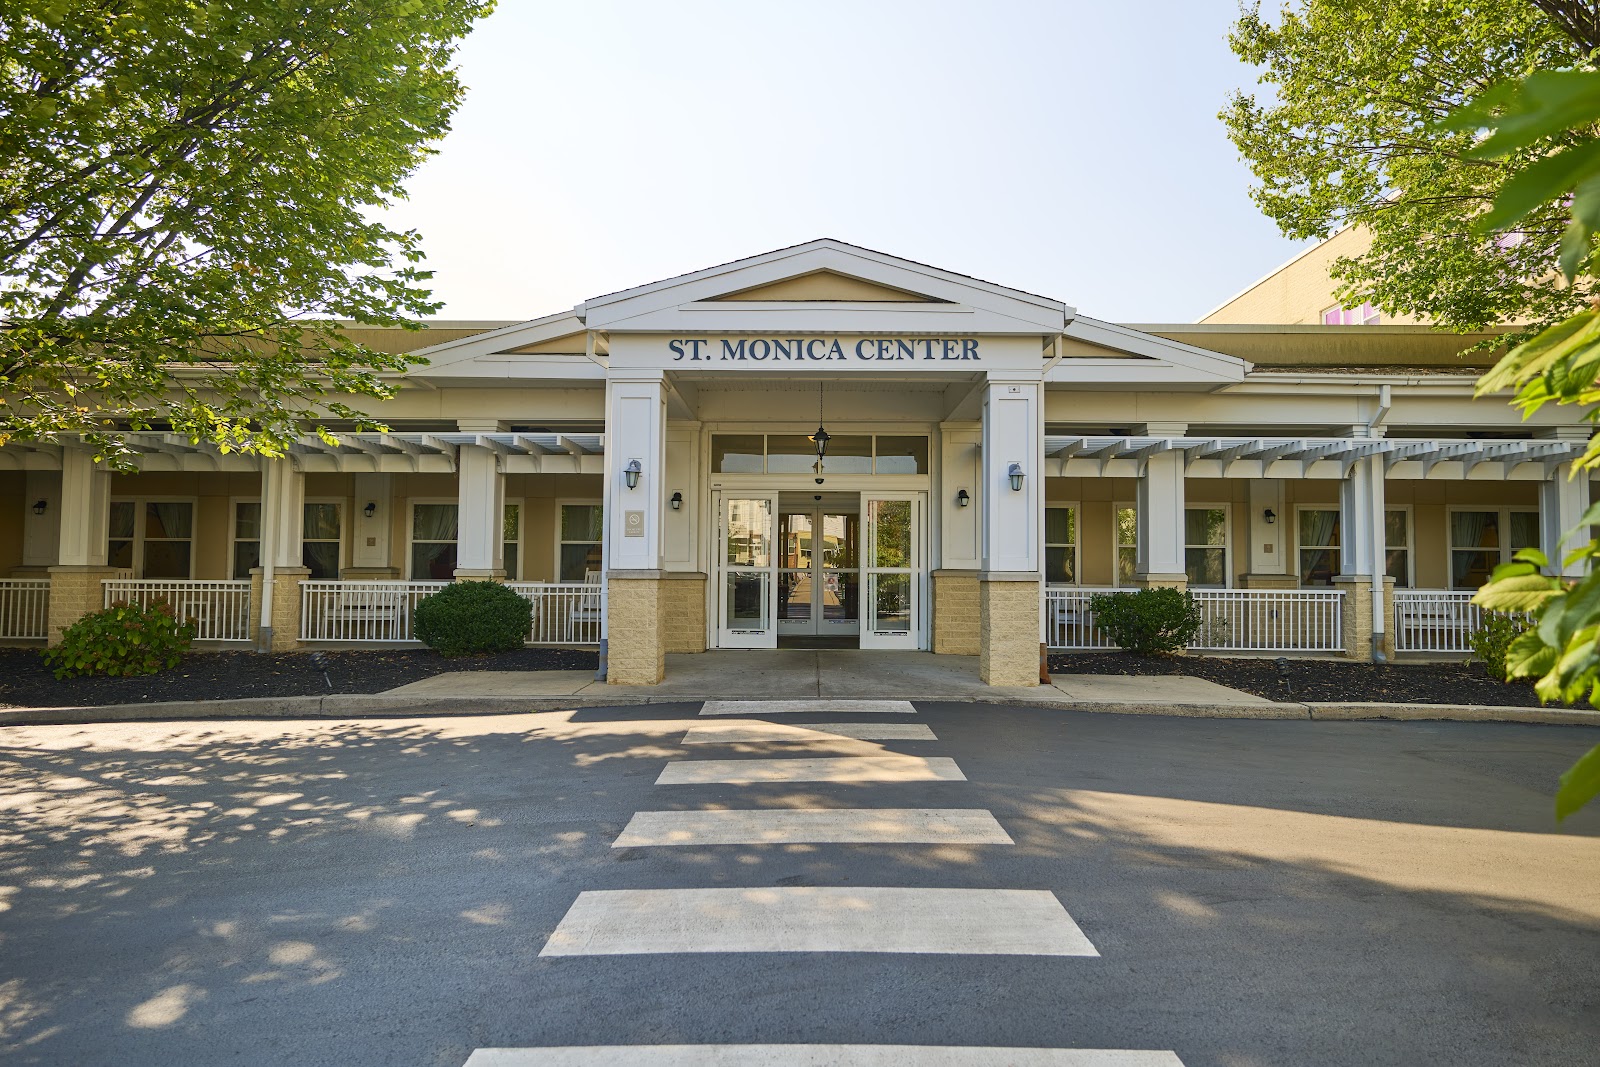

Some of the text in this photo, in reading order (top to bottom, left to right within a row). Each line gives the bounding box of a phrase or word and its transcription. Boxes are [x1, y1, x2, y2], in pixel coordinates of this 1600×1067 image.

[668, 338, 981, 360] ST. MONICA CENTER
